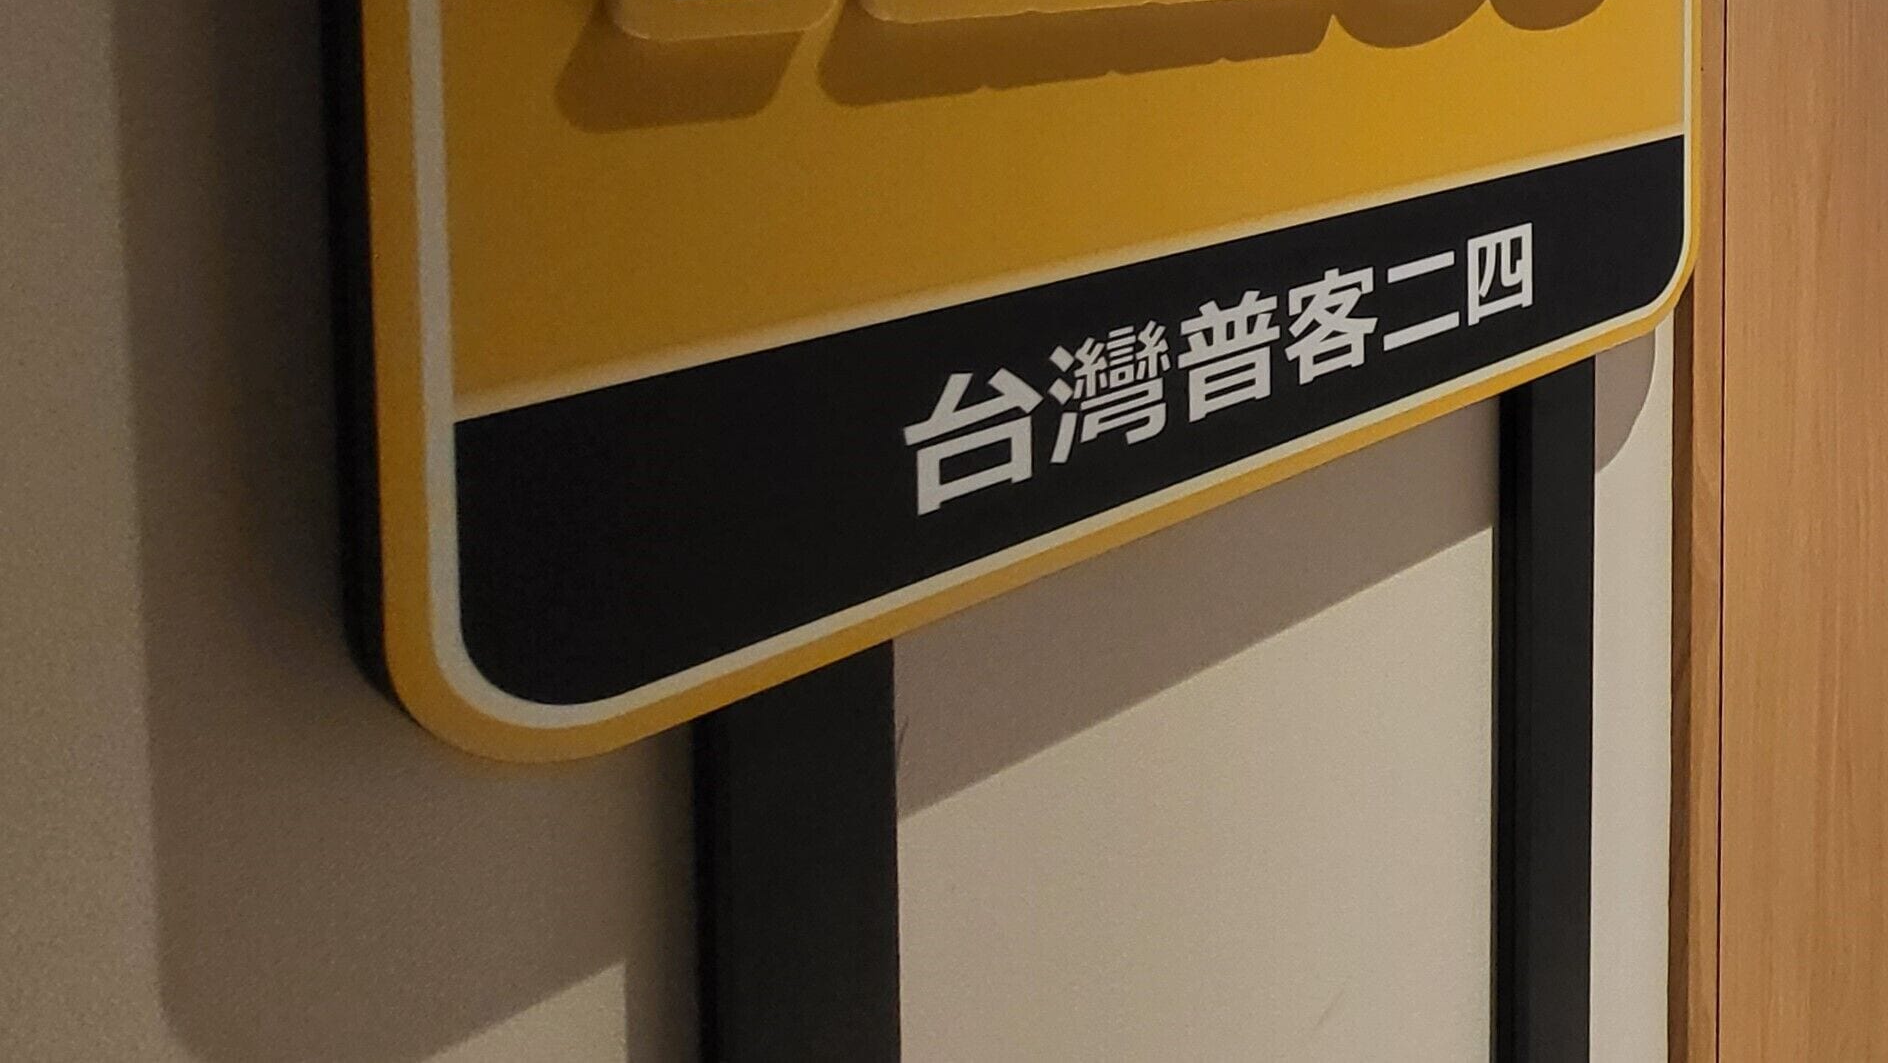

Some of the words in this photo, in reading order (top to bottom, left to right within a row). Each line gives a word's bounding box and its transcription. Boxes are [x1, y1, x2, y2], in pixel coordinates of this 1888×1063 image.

[903, 222, 1533, 516] 台灣普客二四
